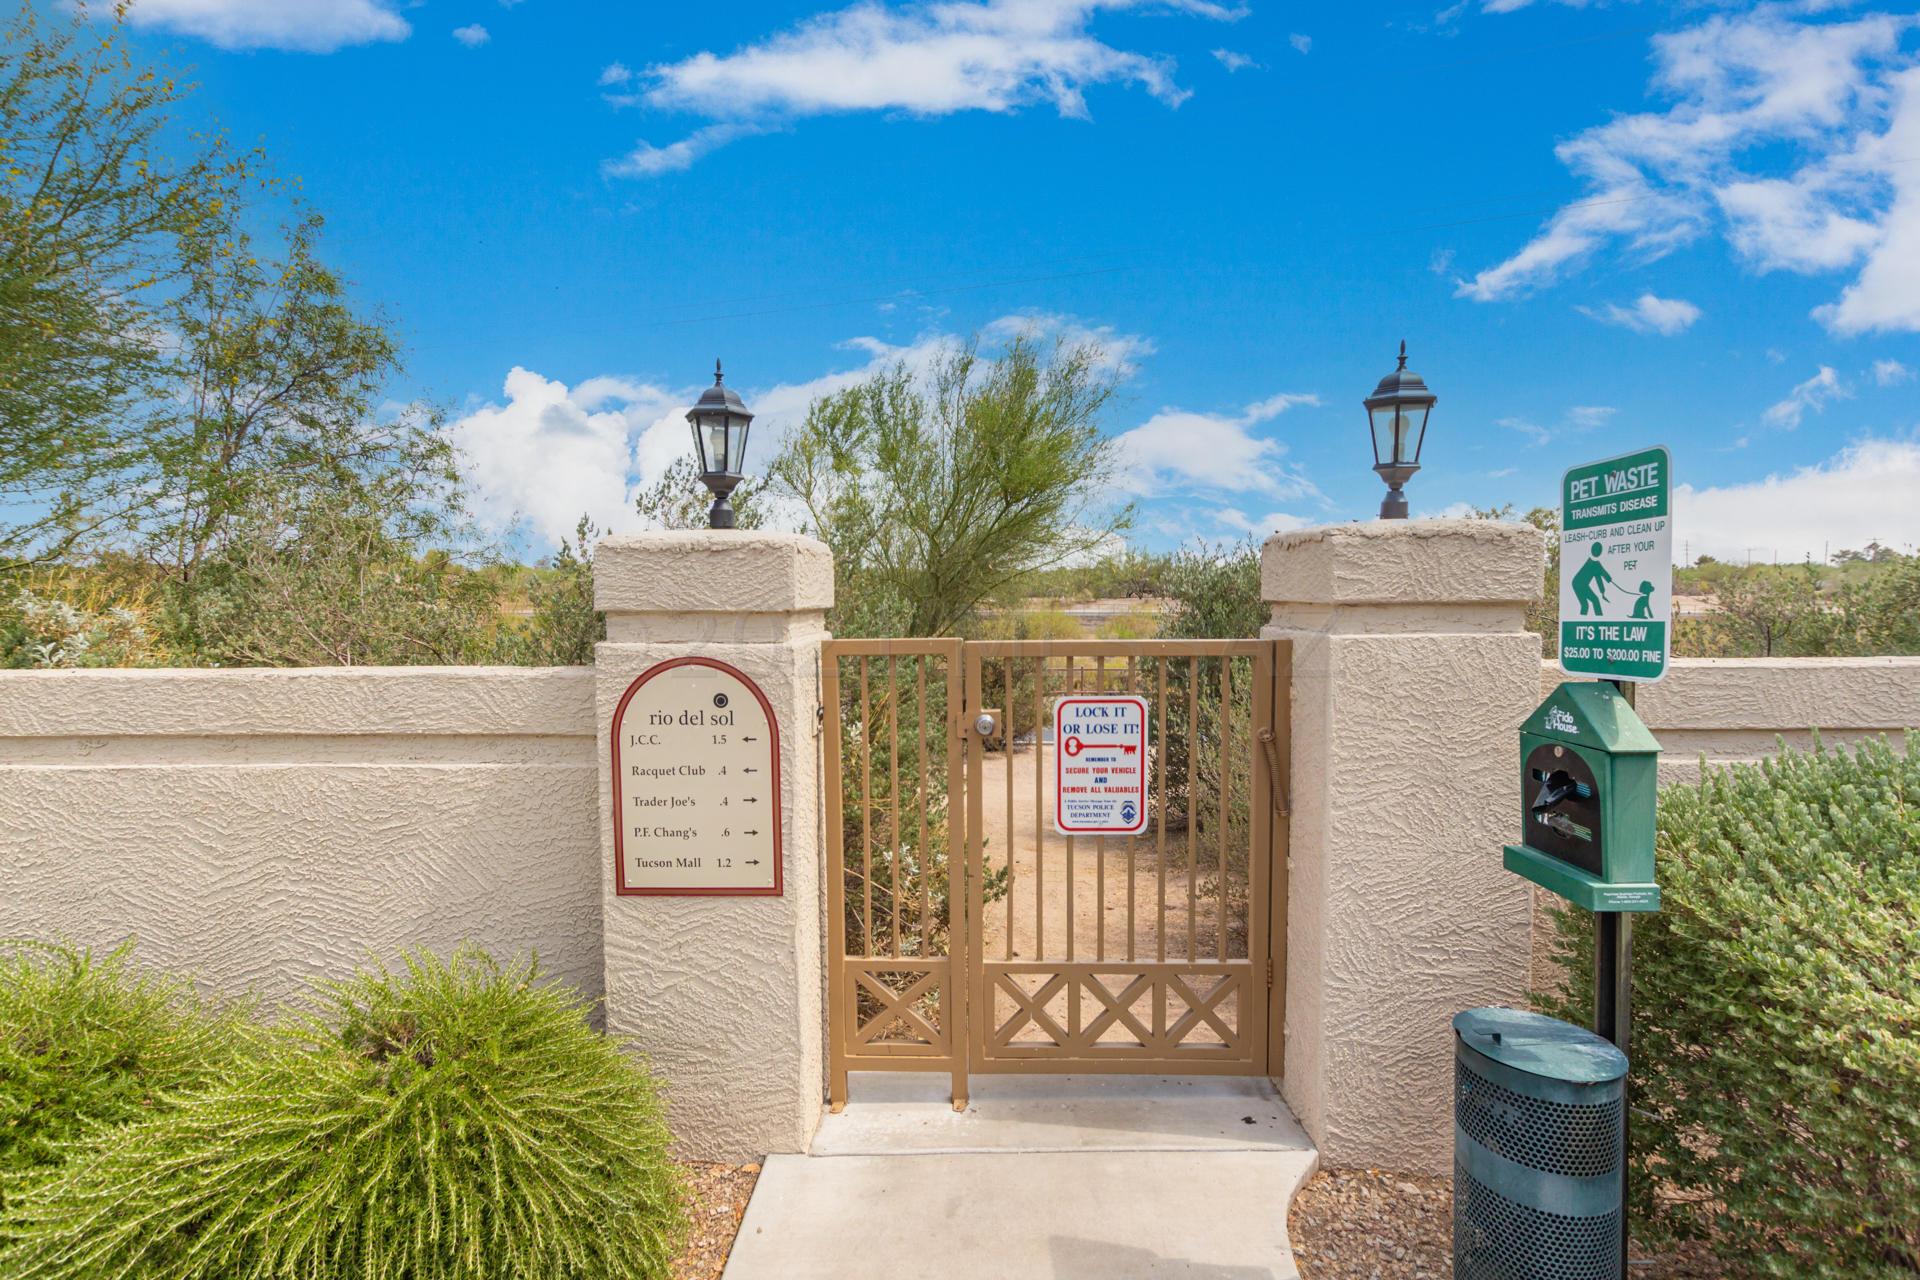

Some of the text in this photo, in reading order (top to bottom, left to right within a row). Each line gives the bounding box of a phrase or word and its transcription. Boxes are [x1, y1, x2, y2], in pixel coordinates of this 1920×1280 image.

[1571, 462, 1658, 500] PET WASTE
[1571, 495, 1658, 520] TRANSMITS DISEASE
[1565, 520, 1665, 543] LEASH-CURB AND CLEAN UP
[1608, 541, 1655, 555] AFTER YOUR
[1624, 559, 1638, 571] PET
[1576, 625, 1648, 642] IT'S THE LAW
[1563, 646, 1662, 663] $25.00 TO $200.00 FINE
[650, 710, 734, 726] rio del sol
[1075, 707, 1128, 718] LOCK IT
[1063, 724, 1140, 735] OR LOSE IT!
[630, 735, 727, 747] J.C.C. 1.5
[632, 765, 728, 779] Racquet Club .4
[1062, 786, 1140, 794] REMOVE ALL VALUABLES
[633, 796, 729, 808] Trader Joe's .4
[634, 827, 730, 840] P.F. Chang's .6
[635, 857, 732, 868] Tucson Mall 1.2
